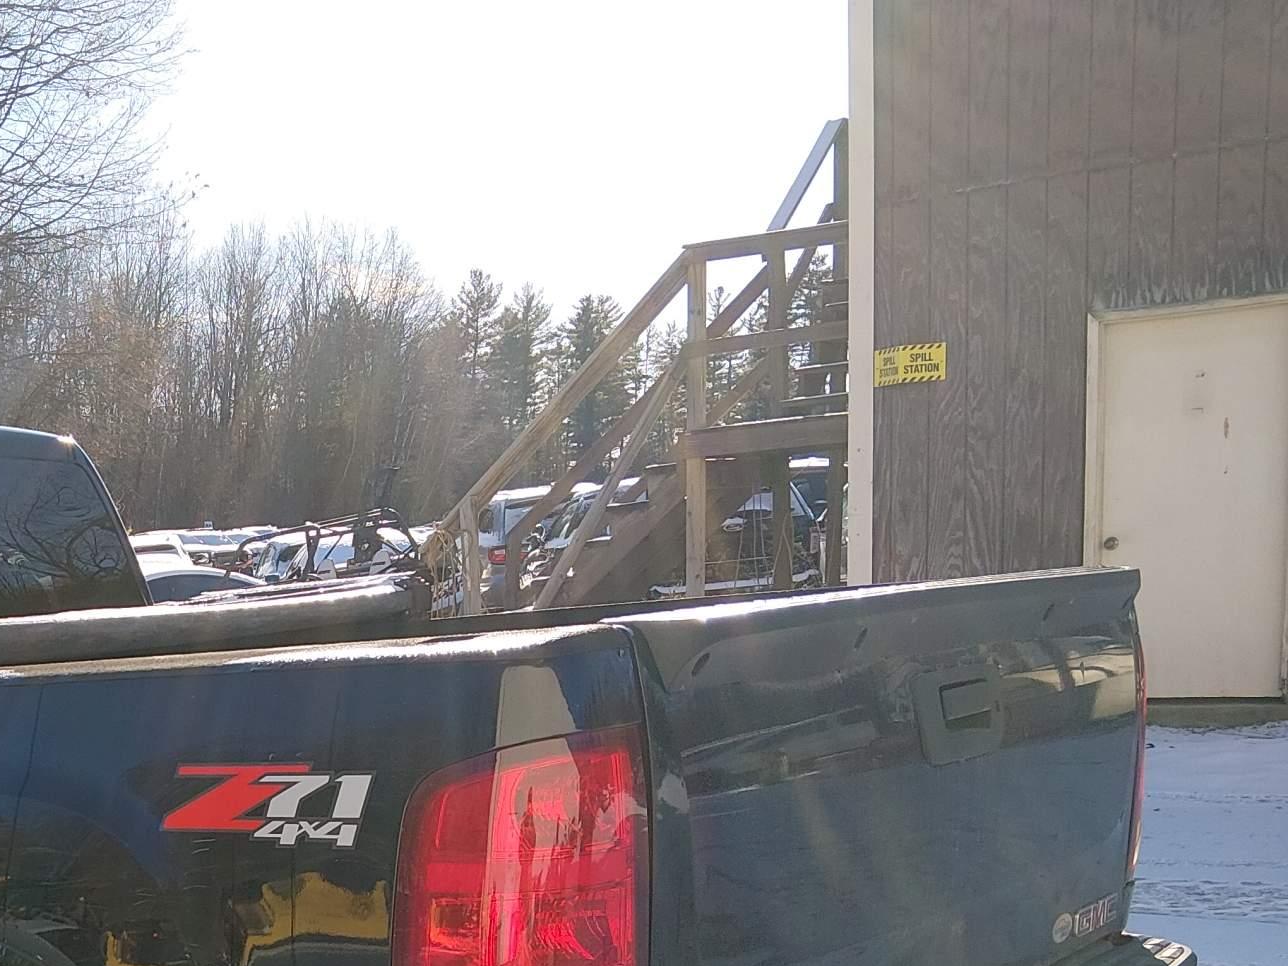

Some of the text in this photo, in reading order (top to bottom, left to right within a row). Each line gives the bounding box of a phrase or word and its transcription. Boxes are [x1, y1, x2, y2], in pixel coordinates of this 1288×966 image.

[903, 363, 939, 374] STATION
[910, 352, 933, 362] SPILL
[163, 765, 373, 829] Z71
[1074, 893, 1118, 937] GMC
